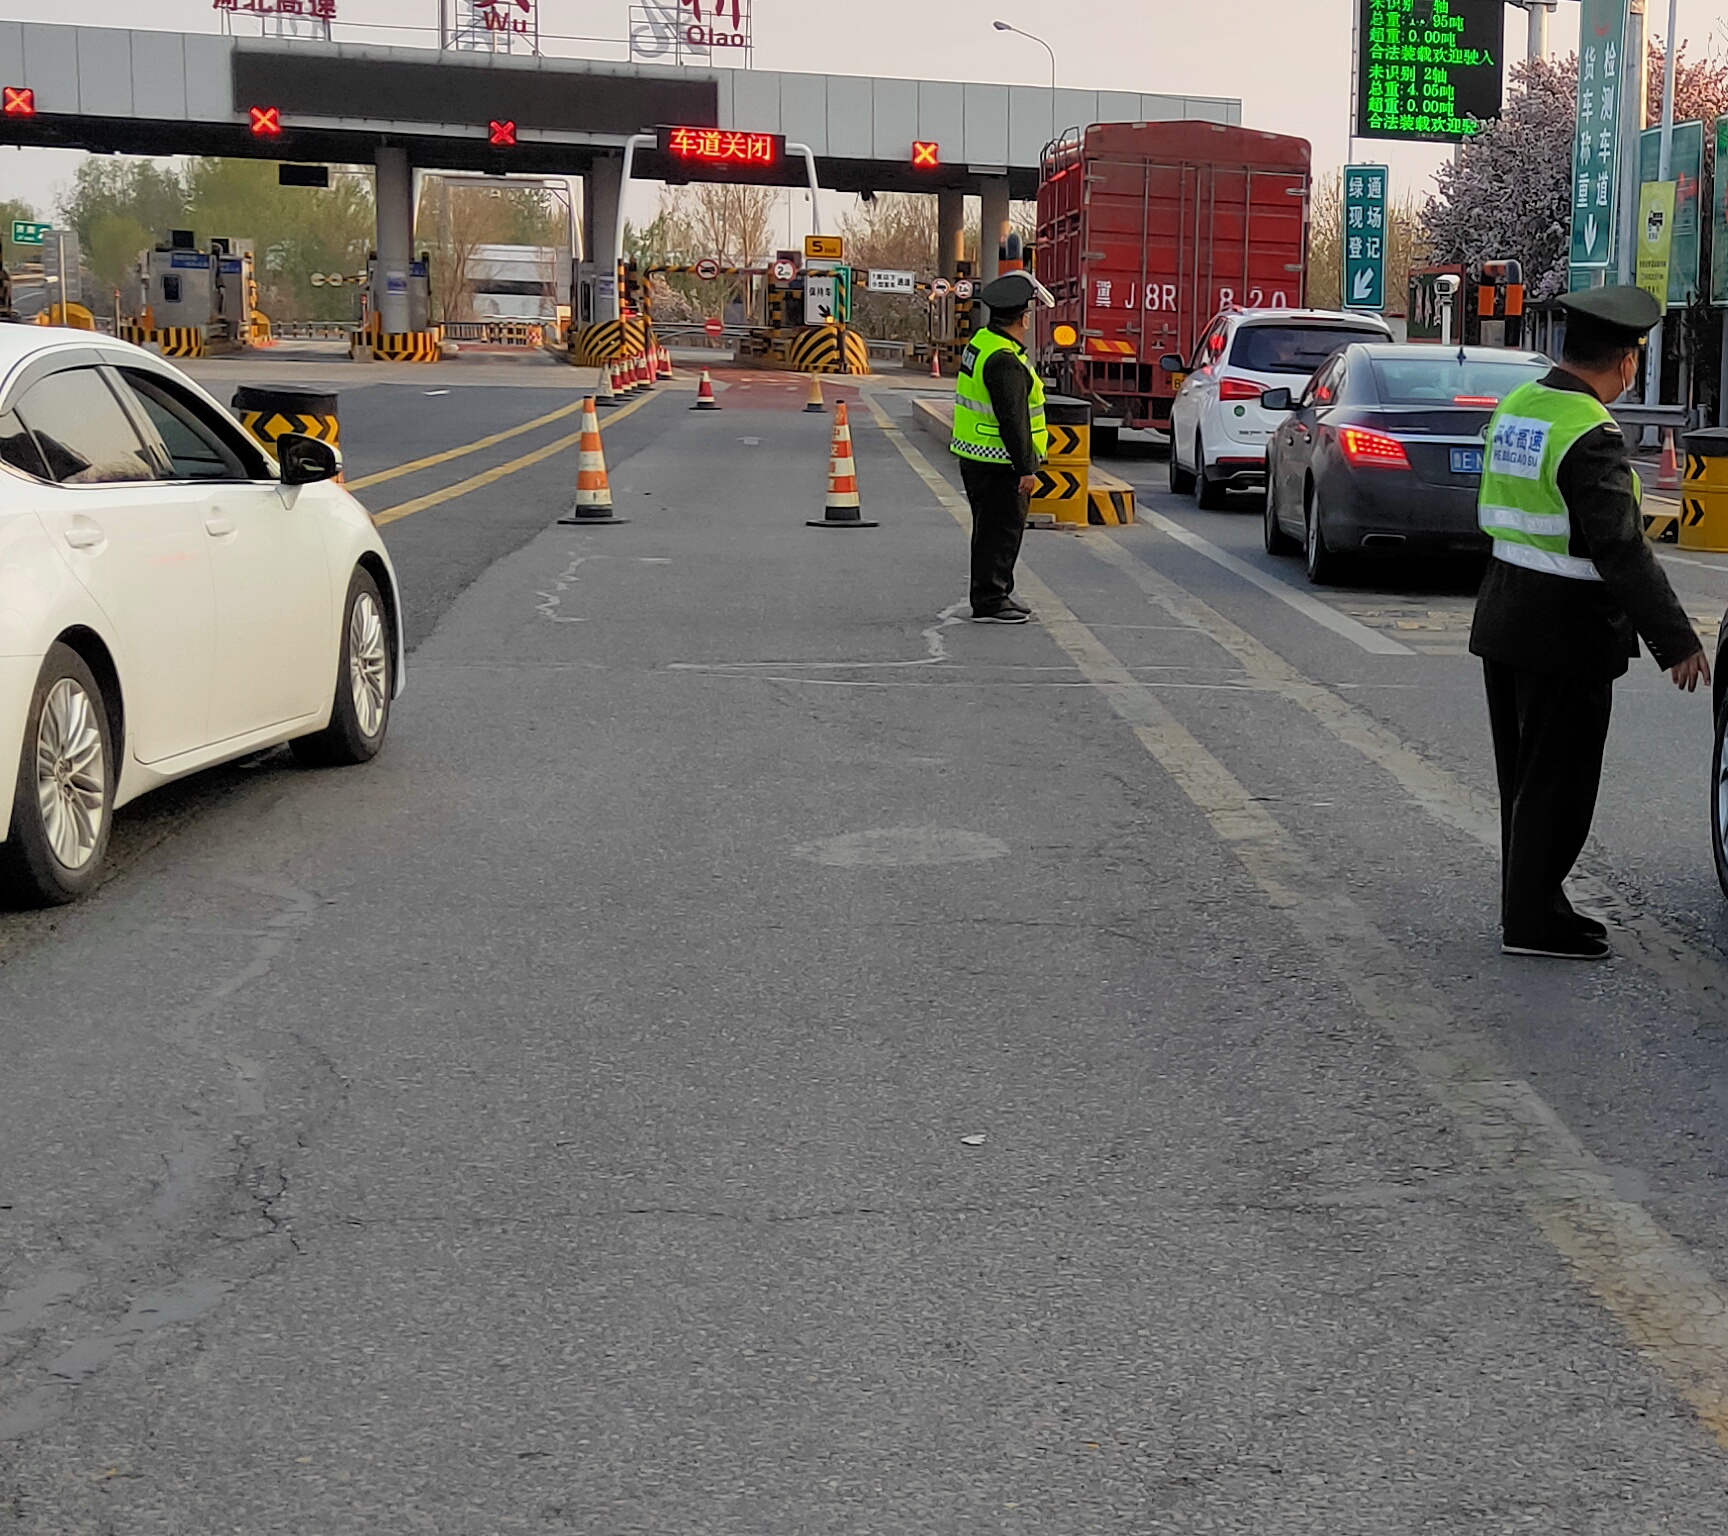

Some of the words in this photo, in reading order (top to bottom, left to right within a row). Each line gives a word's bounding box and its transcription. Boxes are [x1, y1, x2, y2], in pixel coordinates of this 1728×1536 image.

[483, 6, 526, 33] Wu
[687, 25, 744, 47] Qiao
[1369, 44, 1494, 65] 合法装载欢迎驶入
[1368, 64, 1416, 82] 未识别
[1424, 67, 1447, 84] 2轴
[1368, 80, 1455, 100] 总重:4.05吨
[1576, 46, 1597, 209] 货车称重
[1595, 41, 1617, 207] 检测车道
[669, 129, 772, 161] 车道关闭
[1349, 176, 1382, 199] 绿通
[1349, 206, 1382, 229] 现场
[1349, 236, 1381, 259] 登记
